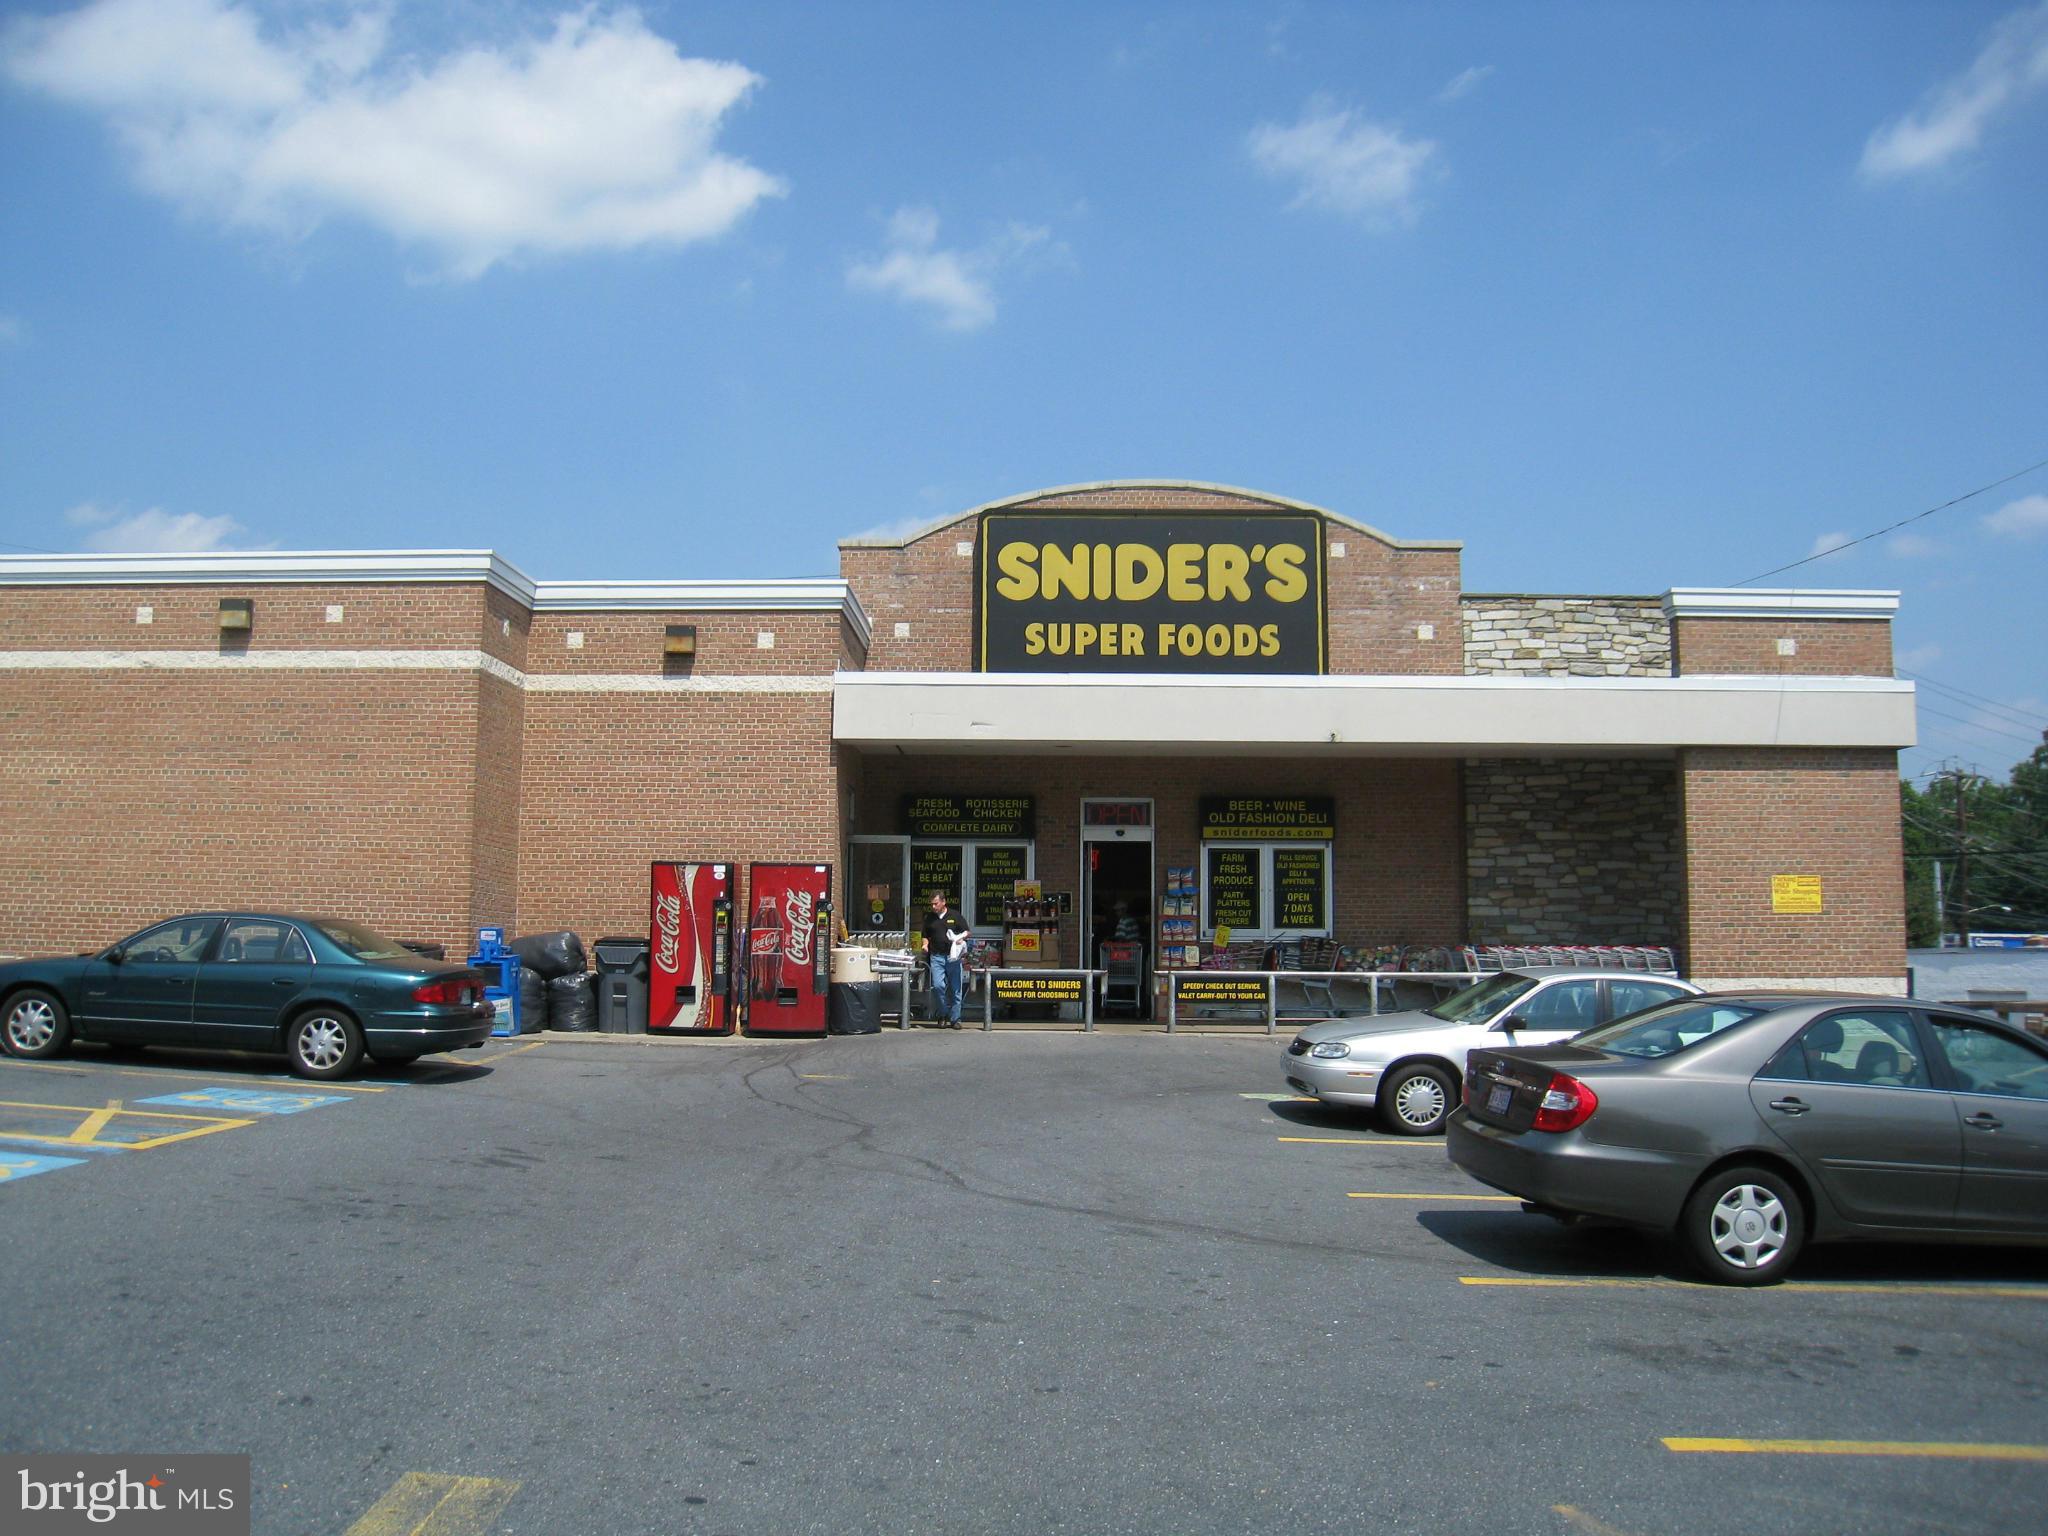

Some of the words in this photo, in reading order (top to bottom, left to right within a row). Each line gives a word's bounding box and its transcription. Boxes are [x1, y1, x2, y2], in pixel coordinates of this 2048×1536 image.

[996, 541, 1308, 603] SNIDER'S
[1024, 622, 1145, 656] SUPER
[1158, 623, 1281, 657] FOODS
[917, 799, 952, 808] FRESH
[965, 799, 1030, 809] ROTISSERIE
[1229, 800, 1263, 811] BEER
[1273, 800, 1307, 811] WINE
[908, 808, 960, 817] SEAFOOD
[973, 808, 1022, 818] CHICKEN
[1088, 804, 1146, 825] OPEN
[1209, 812, 1236, 823] OLD
[1239, 812, 1296, 823] FASHION
[1299, 812, 1328, 824] DELI
[922, 823, 980, 832] COMPLETE
[982, 823, 1015, 832] DAIRY
[1212, 828, 1324, 837] sniderfoods.com
[925, 851, 948, 860] MEAT
[1221, 853, 1245, 863] FARM
[913, 862, 934, 871] THAT
[1219, 864, 1247, 874] FRESH
[919, 873, 931, 882] BE
[932, 873, 953, 882] BEAT
[1213, 875, 1254, 885] PRODUCE
[1223, 891, 1244, 899] PARTY
[1287, 893, 1310, 902] OPEN
[1216, 899, 1251, 907] PLATTERS
[1215, 909, 1237, 917] FRESH
[1238, 909, 1252, 917] CUT
[1283, 904, 1289, 913] 7
[1291, 904, 1313, 913] DAYS
[1217, 917, 1249, 925] FLOWERS
[1282, 915, 1289, 924] A
[1290, 915, 1315, 924] WEEK
[995, 980, 1034, 989] WELCOME
[1035, 980, 1046, 989] TO
[1047, 980, 1081, 989] SNIDERS
[1182, 982, 1205, 990] SPEEDY
[1205, 982, 1224, 990] CHECK
[1224, 982, 1236, 990] OUT
[1237, 982, 1261, 990] SERVICE
[997, 990, 1022, 998] THANKS
[1037, 991, 1069, 999] CHOOSING
[1070, 991, 1080, 999] US
